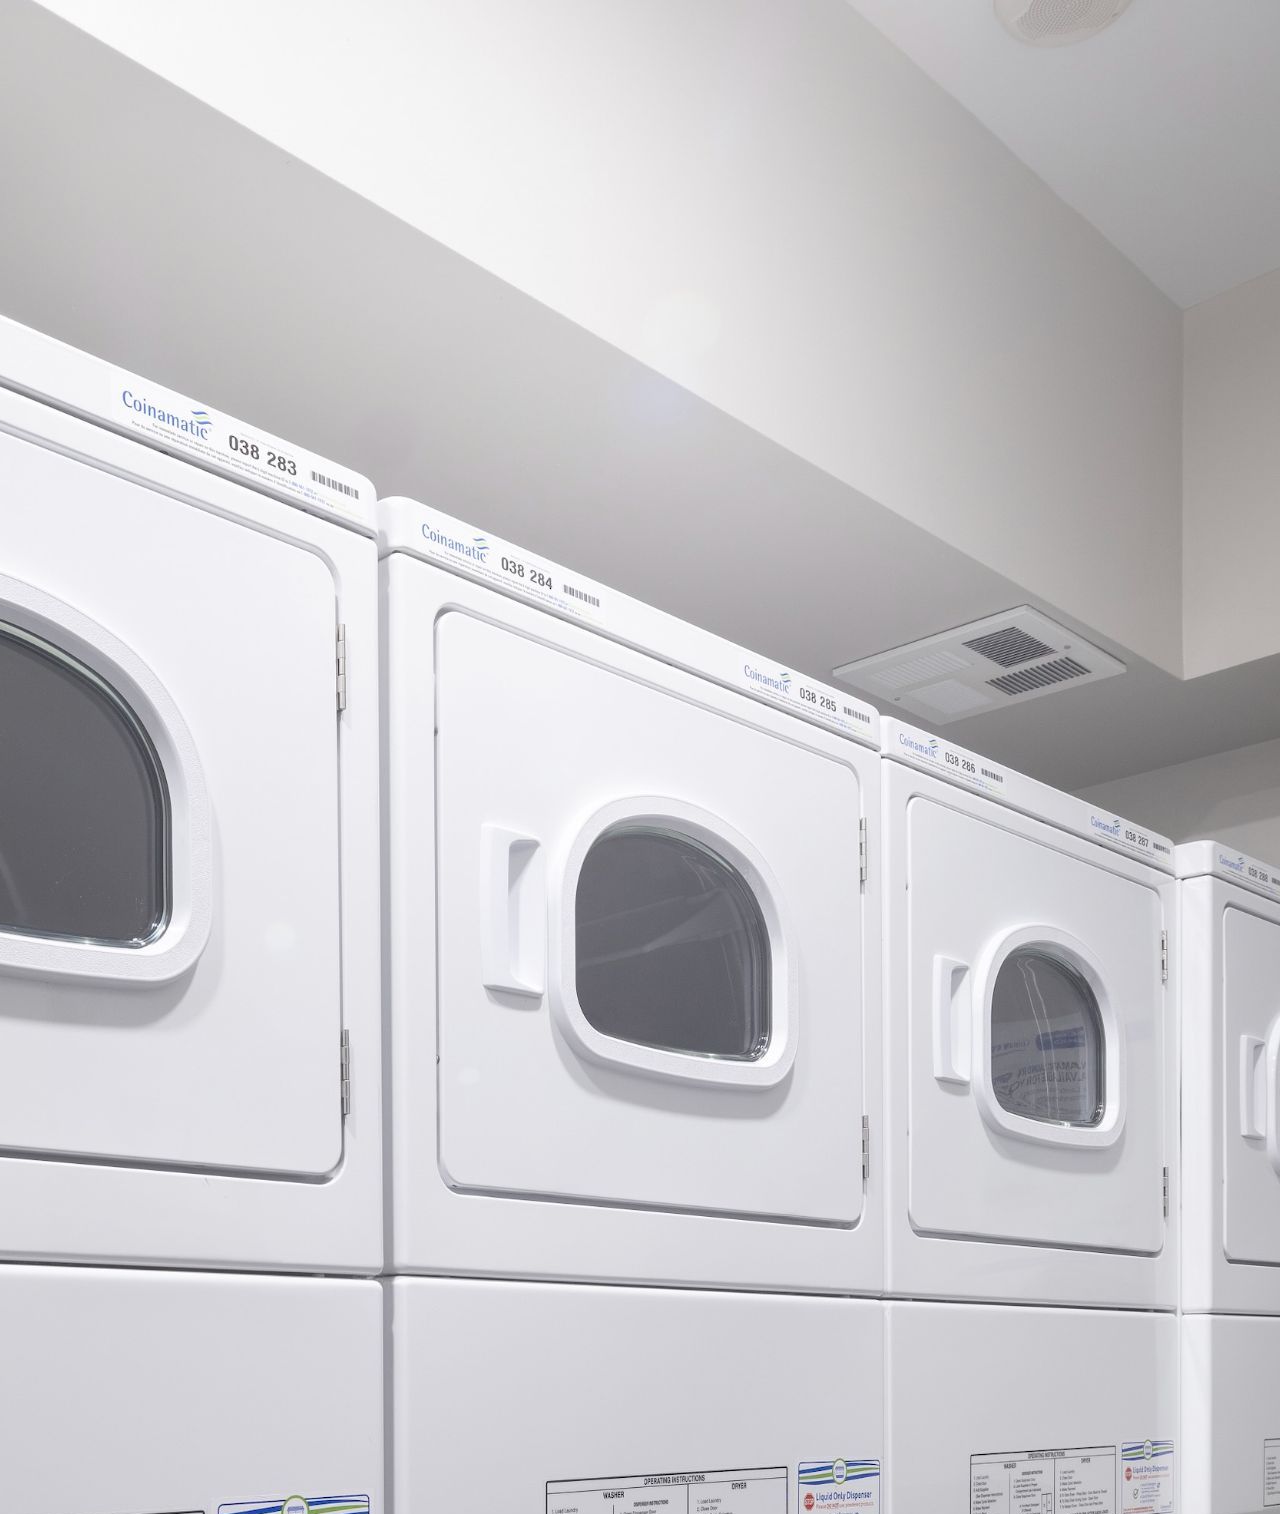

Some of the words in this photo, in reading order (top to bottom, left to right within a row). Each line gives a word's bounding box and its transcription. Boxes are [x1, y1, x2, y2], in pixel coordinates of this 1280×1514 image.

[122, 390, 208, 440] Coinamatic
[229, 435, 260, 460] 038
[267, 451, 297, 476] 283
[422, 523, 487, 563] Coinamatic
[501, 557, 524, 578] 038
[530, 569, 553, 589] 284
[744, 664, 789, 694] Coinamatic
[800, 687, 816, 703] 038
[820, 696, 836, 712] 285
[900, 733, 936, 758] Coinamatic
[945, 752, 959, 766] 038
[962, 760, 975, 774] 286
[671, 1475, 705, 1483] INSTRUCTIONS
[732, 1482, 746, 1490] DRYER
[816, 1492, 832, 1502] Liquid
[834, 1491, 846, 1501] Only
[847, 1491, 872, 1500] Dispenser
